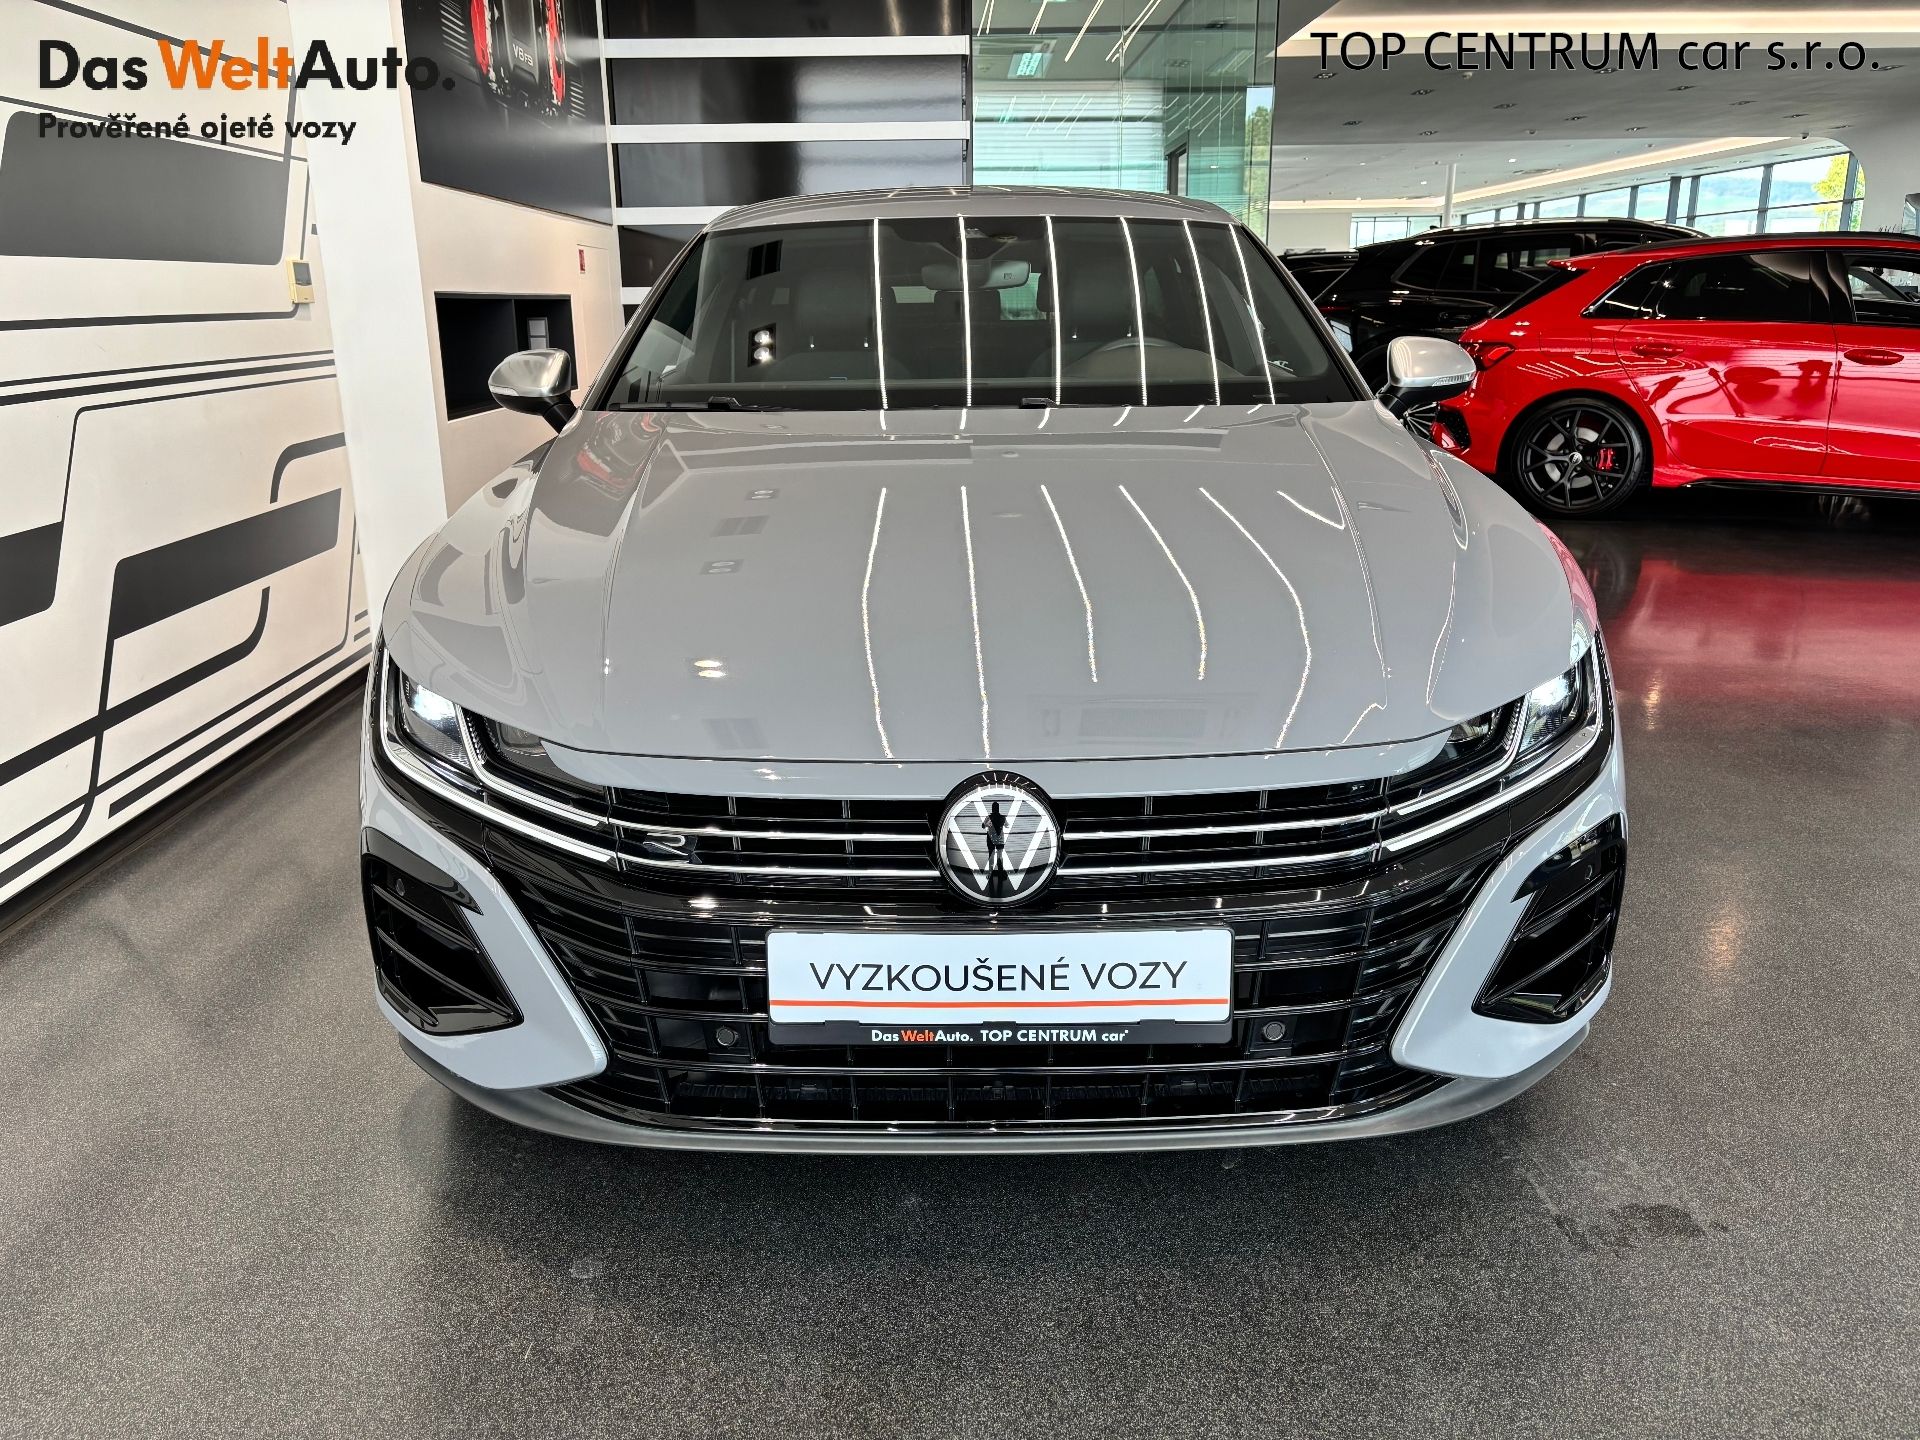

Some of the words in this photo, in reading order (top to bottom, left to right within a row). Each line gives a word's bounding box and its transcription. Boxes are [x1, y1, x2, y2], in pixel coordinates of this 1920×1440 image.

[809, 956, 1071, 992] VYZKOUŠENÉ
[1081, 959, 1189, 990] VOZY
[871, 1029, 899, 1042] Das
[980, 1029, 1012, 1042] TOP
[1016, 1029, 1097, 1042] CENTRUM
